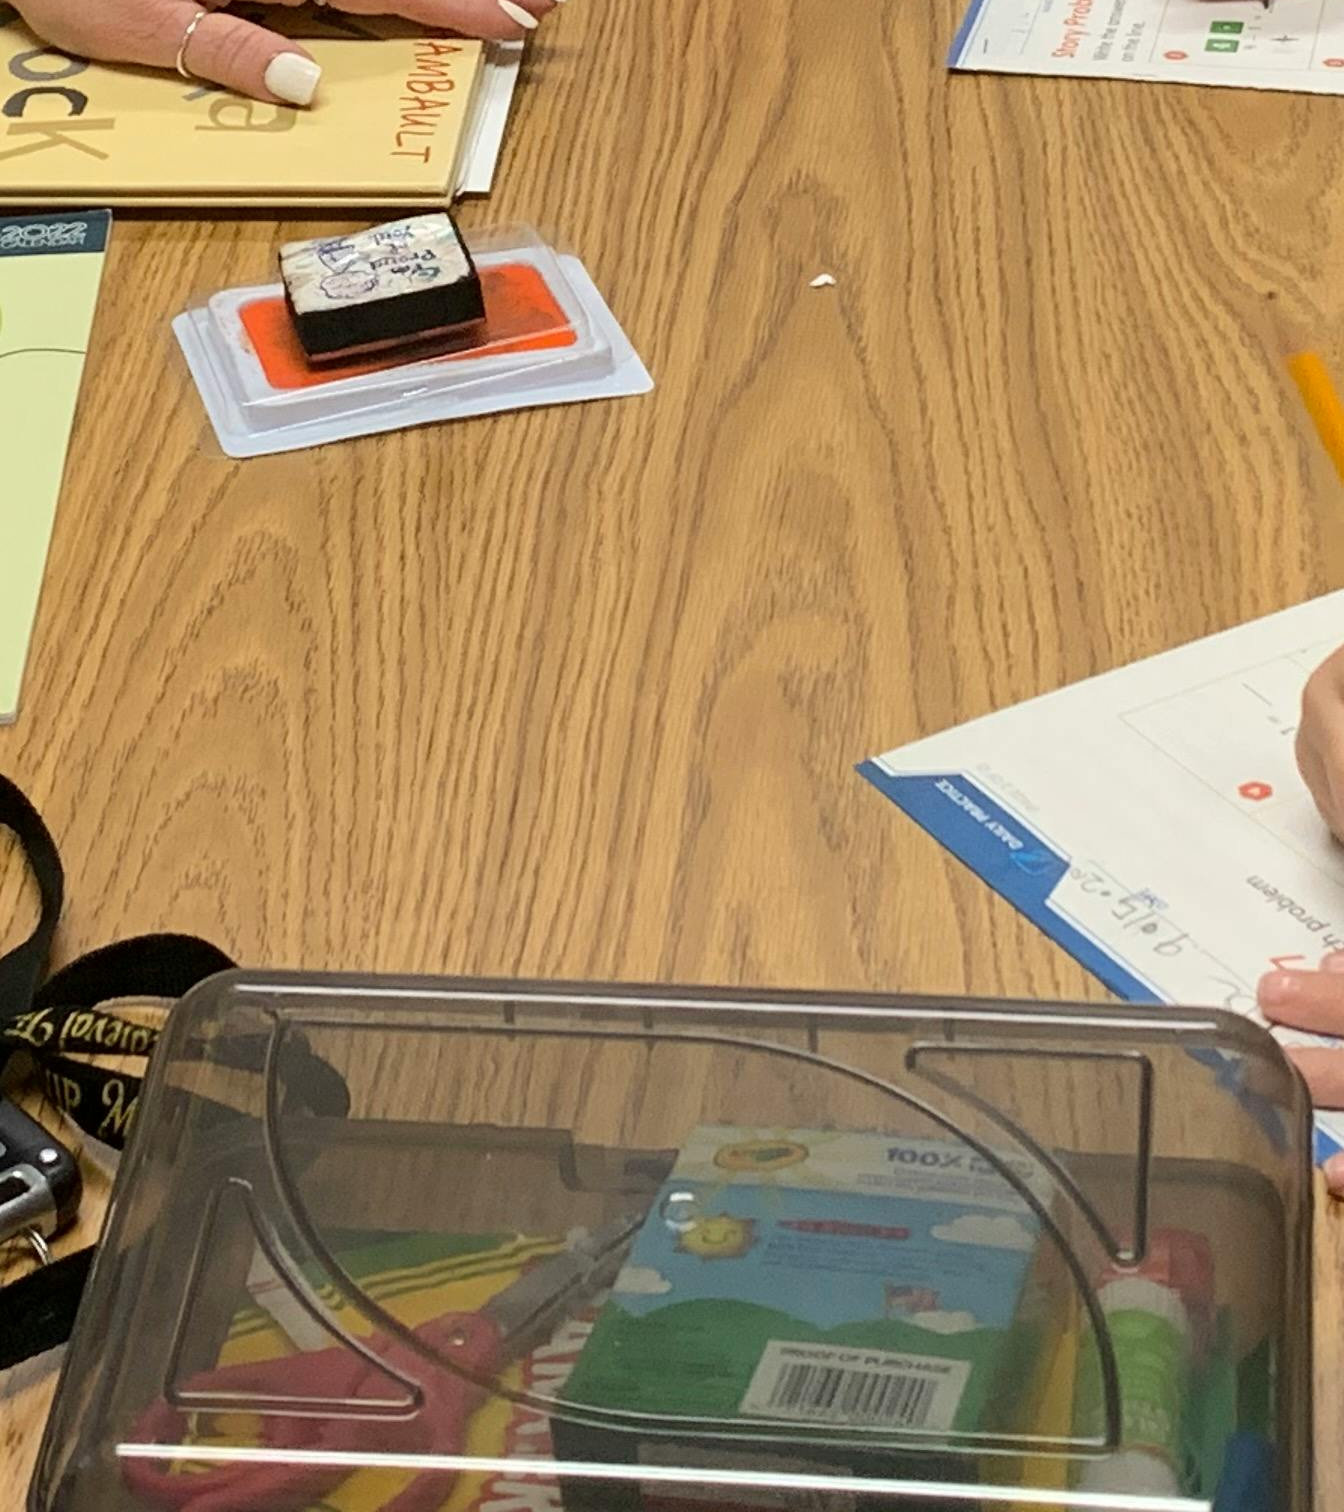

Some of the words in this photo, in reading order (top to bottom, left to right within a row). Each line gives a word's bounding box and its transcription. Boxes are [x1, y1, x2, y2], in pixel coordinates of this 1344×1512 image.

[1051, 29, 1090, 59] Story
[391, 40, 463, 163] AMBAULT
[934, 777, 986, 825] PRACTICE
[983, 821, 1024, 851] DAILY
[1244, 875, 1331, 933] problem
[59, 1010, 157, 1055] dieval
[779, 1346, 838, 1361] PROOF
[841, 1351, 860, 1363] OF
[863, 1356, 953, 1375] PURCHASE
